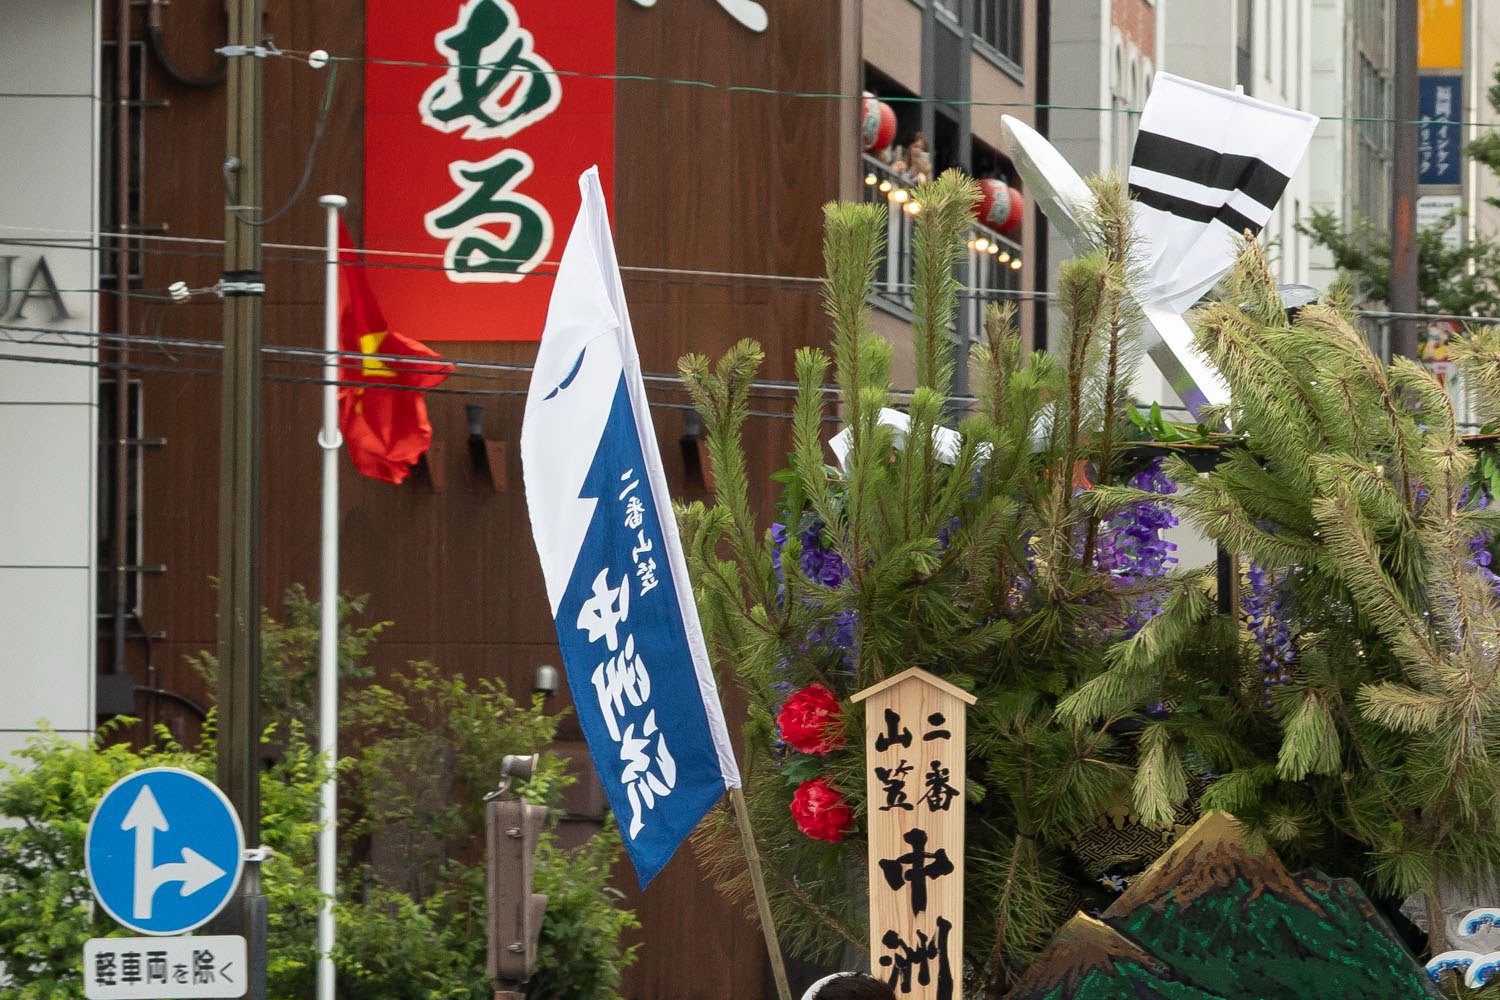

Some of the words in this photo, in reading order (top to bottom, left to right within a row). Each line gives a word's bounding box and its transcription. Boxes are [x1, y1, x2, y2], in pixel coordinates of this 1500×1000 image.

[418, 0, 562, 283] ある
[875, 708, 914, 811] 山笠
[917, 712, 960, 813] 二番
[95, 949, 234, 986] 軽車両を除く
